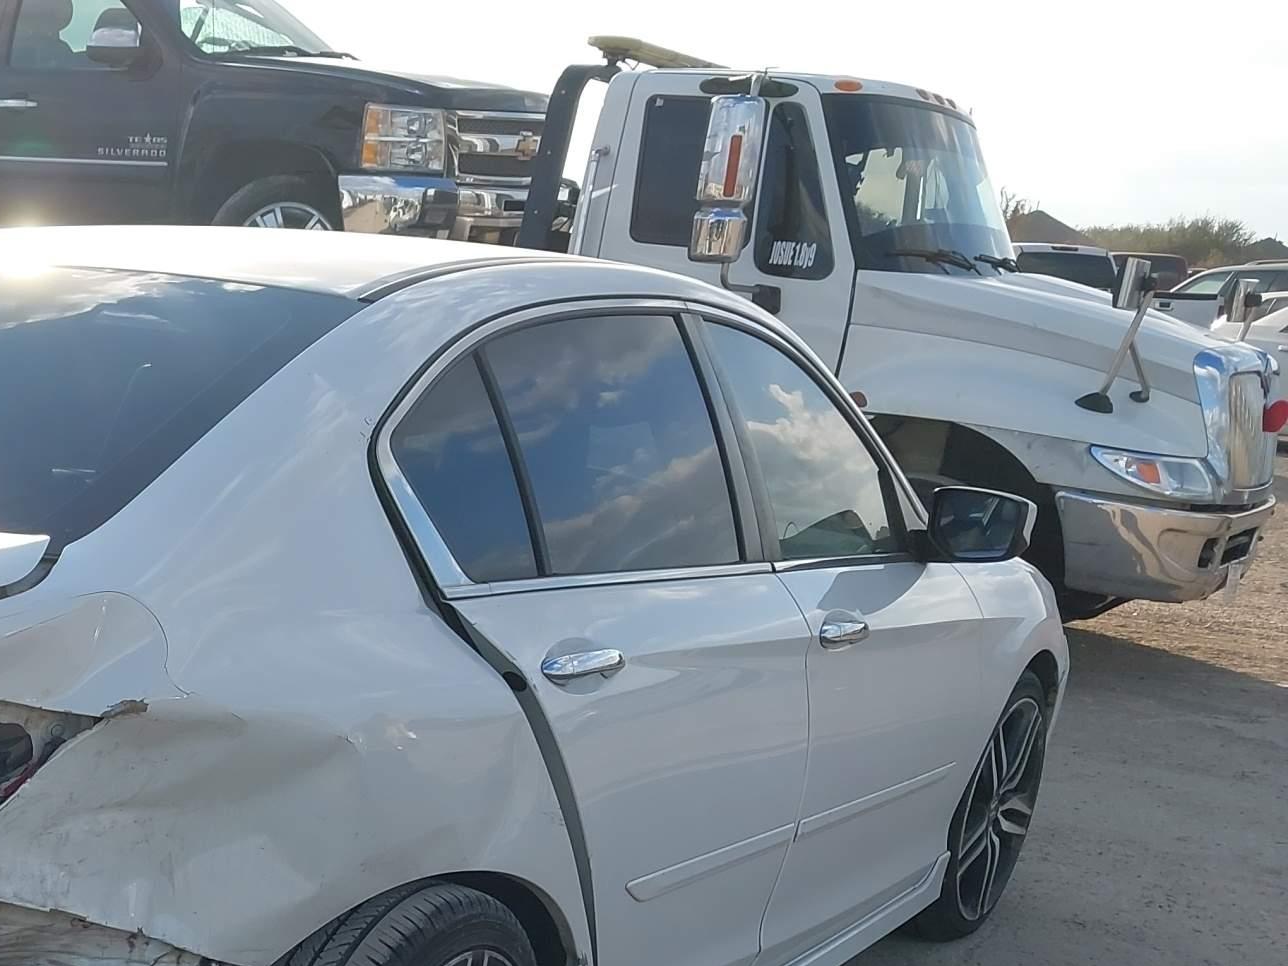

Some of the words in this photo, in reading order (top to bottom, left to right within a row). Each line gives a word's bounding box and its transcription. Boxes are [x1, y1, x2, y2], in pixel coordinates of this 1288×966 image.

[128, 132, 167, 144] TEAS
[97, 147, 167, 157] SILVERADO
[768, 240, 796, 266] JOSUE
